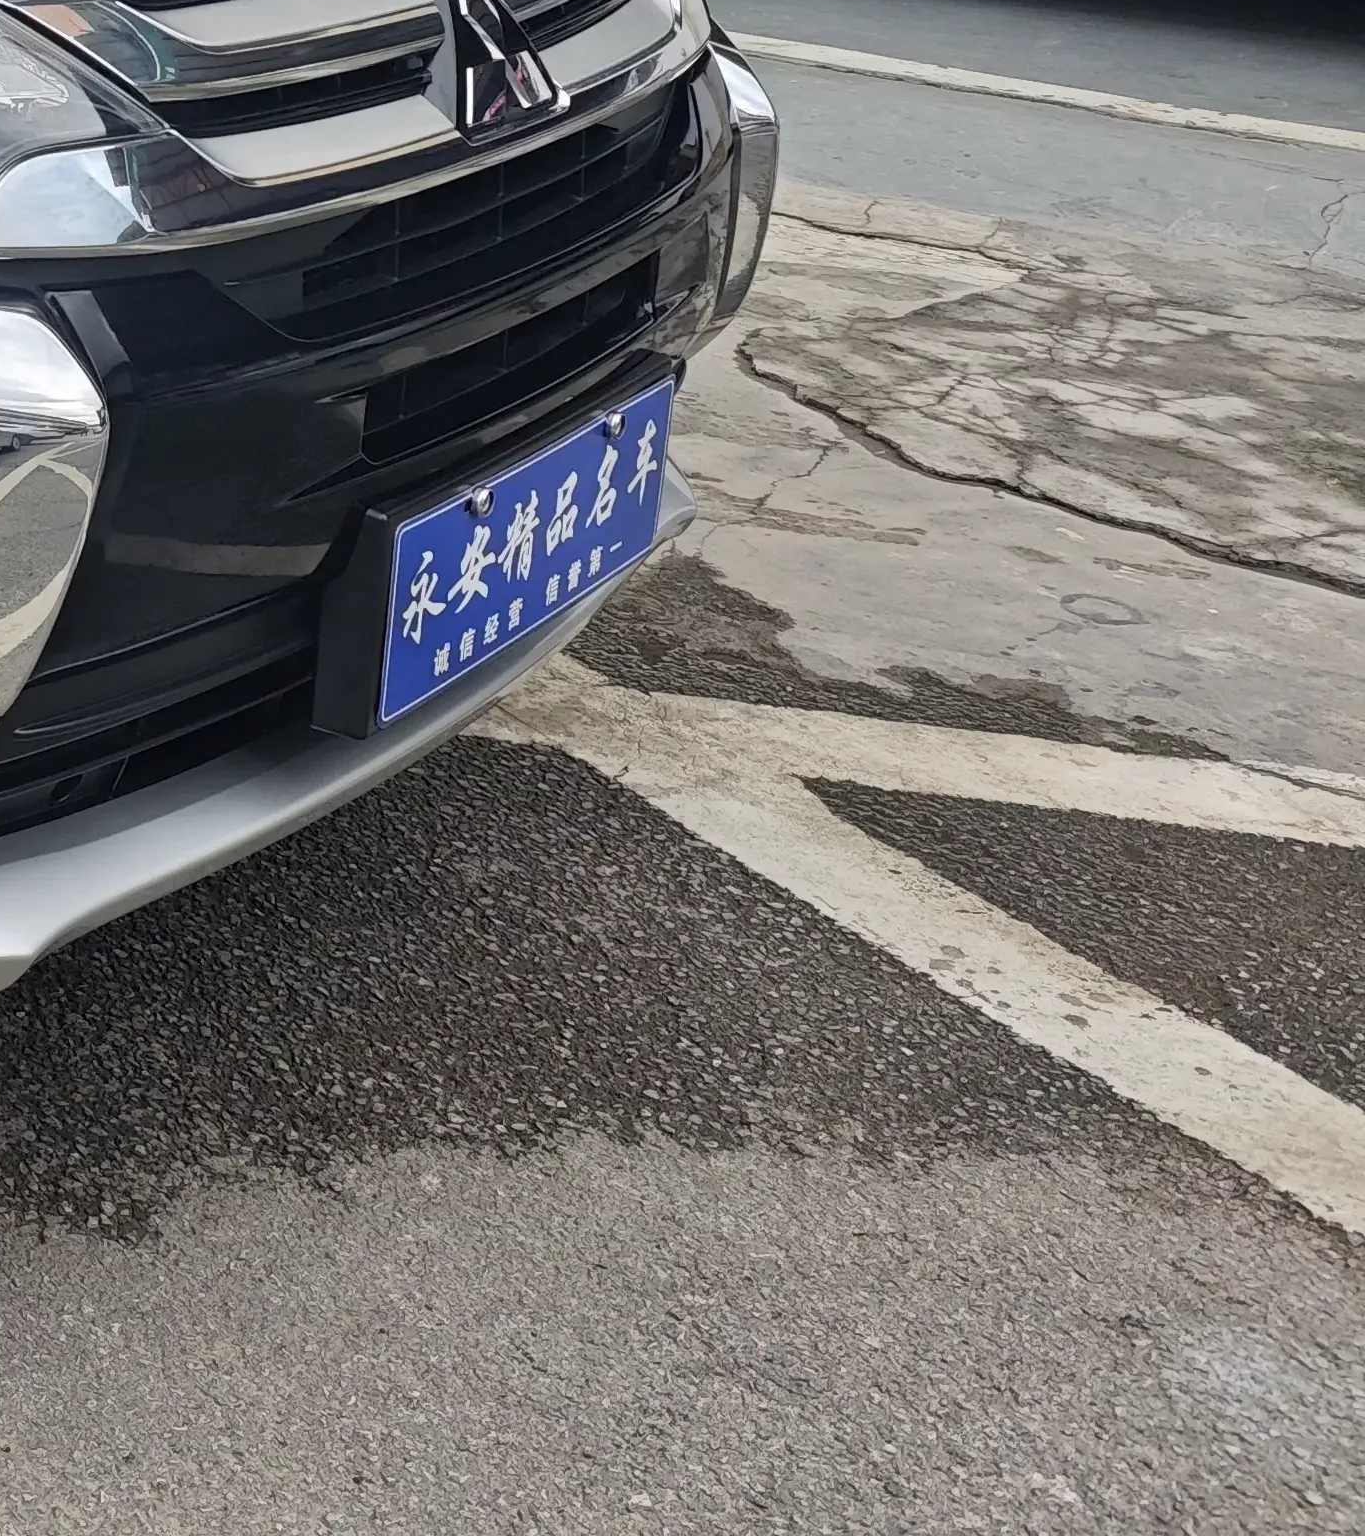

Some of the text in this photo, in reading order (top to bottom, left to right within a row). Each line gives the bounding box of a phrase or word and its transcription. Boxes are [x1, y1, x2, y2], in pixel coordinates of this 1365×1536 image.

[402, 419, 657, 645] 永安精品名车
[433, 540, 623, 677] 诚信经营 信誉第一
